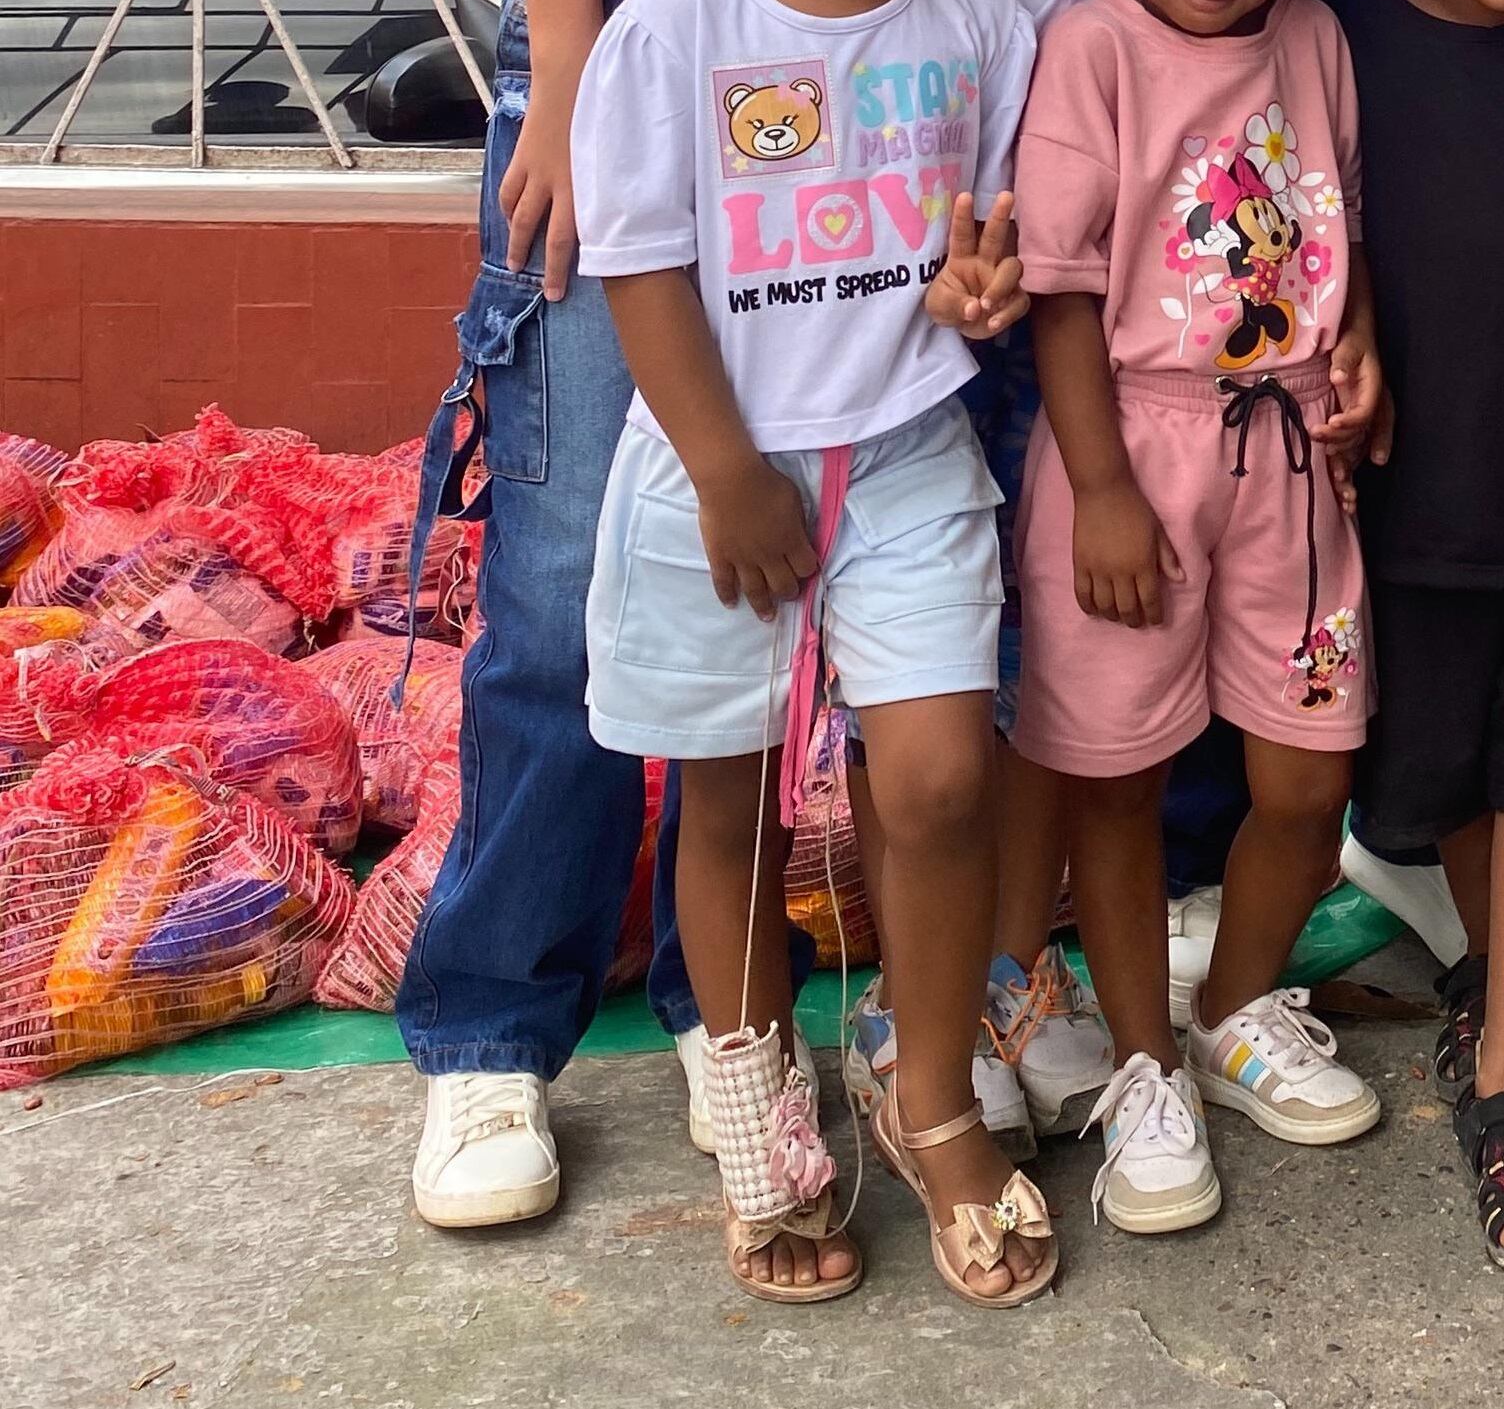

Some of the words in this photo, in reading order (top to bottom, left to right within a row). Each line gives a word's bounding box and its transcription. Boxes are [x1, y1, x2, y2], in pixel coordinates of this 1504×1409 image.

[728, 288, 761, 314] WE
[767, 277, 827, 306] MUST
[835, 264, 911, 300] SPREAD
